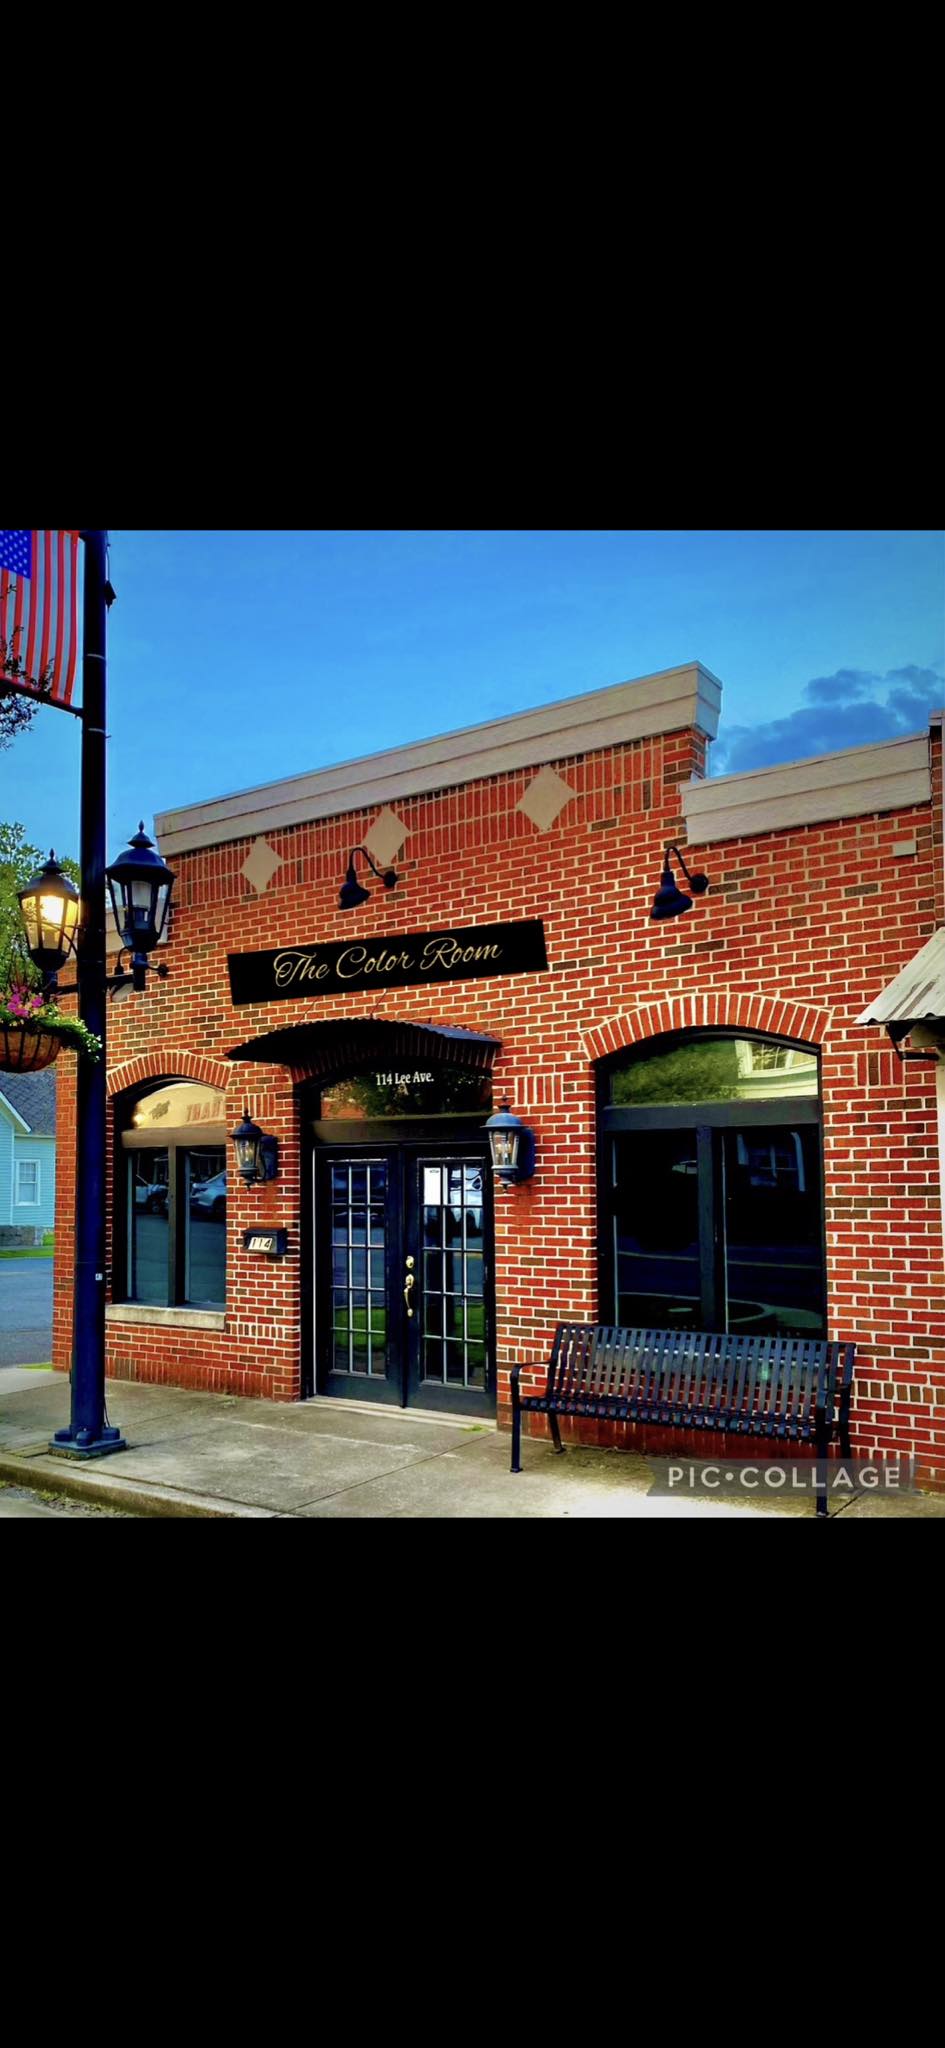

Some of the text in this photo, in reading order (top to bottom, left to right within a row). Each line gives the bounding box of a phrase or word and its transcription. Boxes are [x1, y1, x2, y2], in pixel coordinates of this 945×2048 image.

[273, 937, 503, 987] The Color Room
[375, 1071, 435, 1086] 114 Lee Ave.
[252, 1238, 273, 1250] 114
